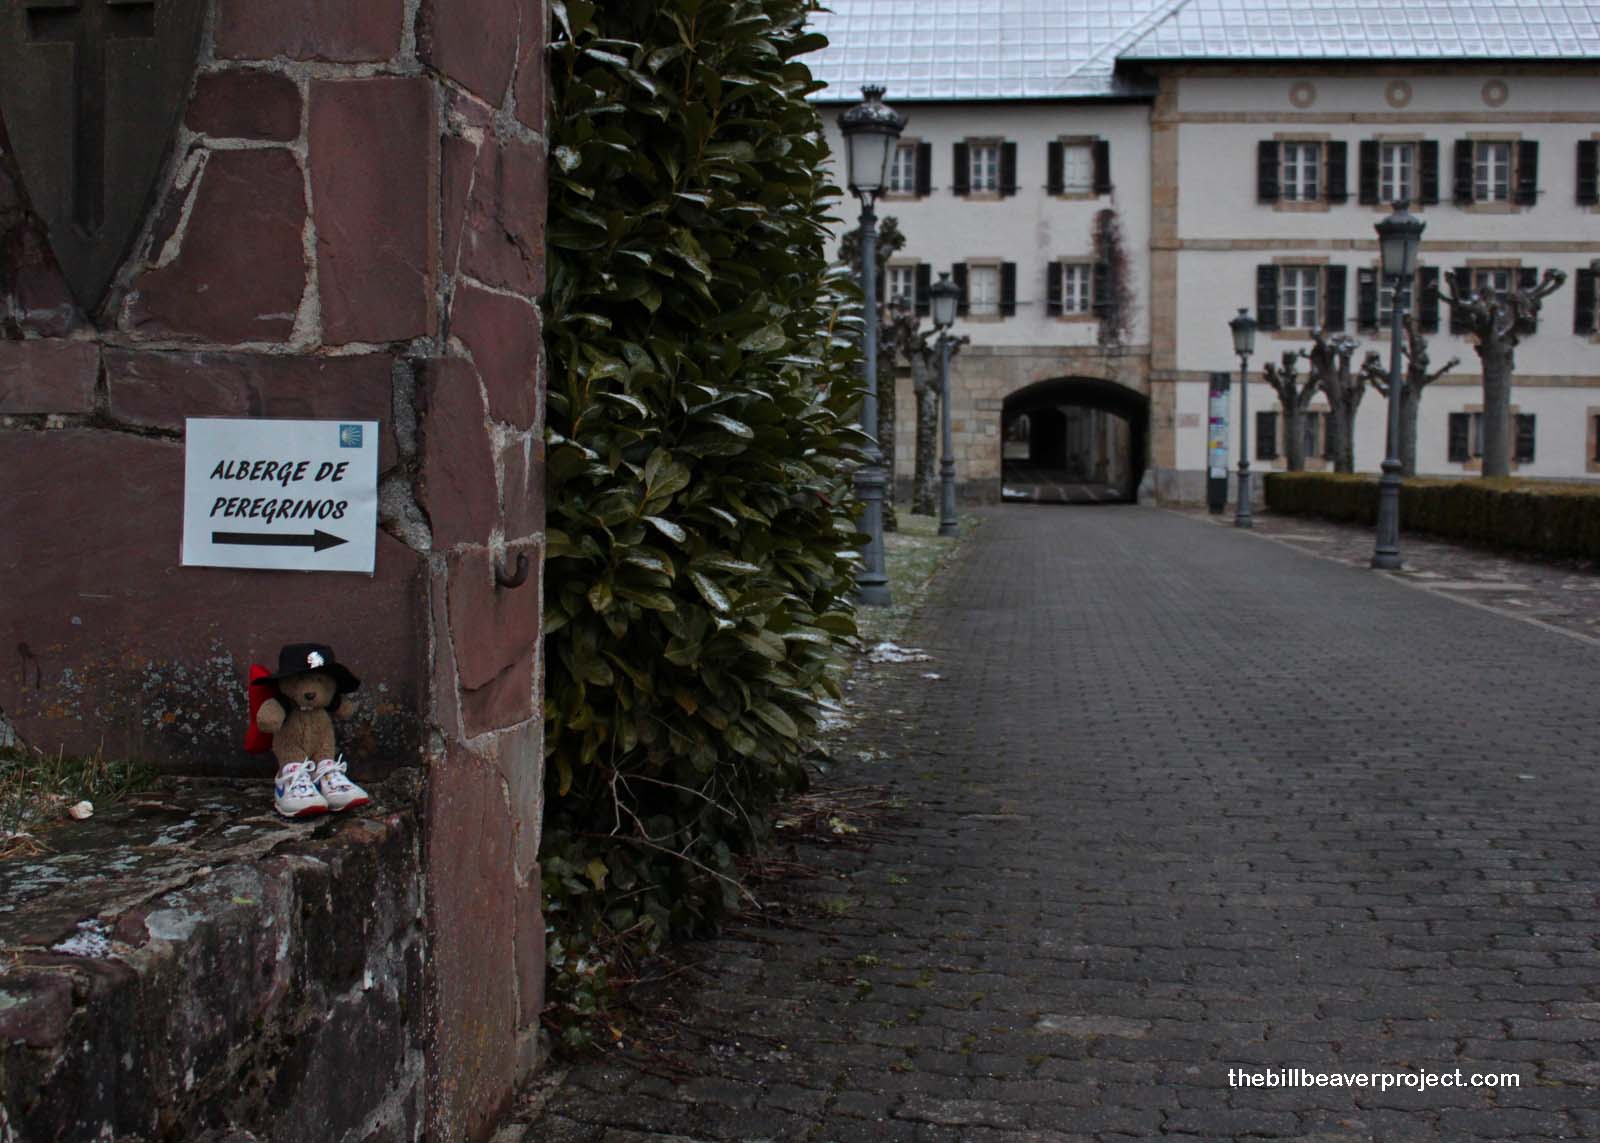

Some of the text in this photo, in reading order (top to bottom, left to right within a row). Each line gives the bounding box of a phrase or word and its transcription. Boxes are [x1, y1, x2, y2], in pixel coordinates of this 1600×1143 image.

[210, 460, 350, 487] ALBERGE DE
[210, 497, 349, 524] PEREGRINOS
